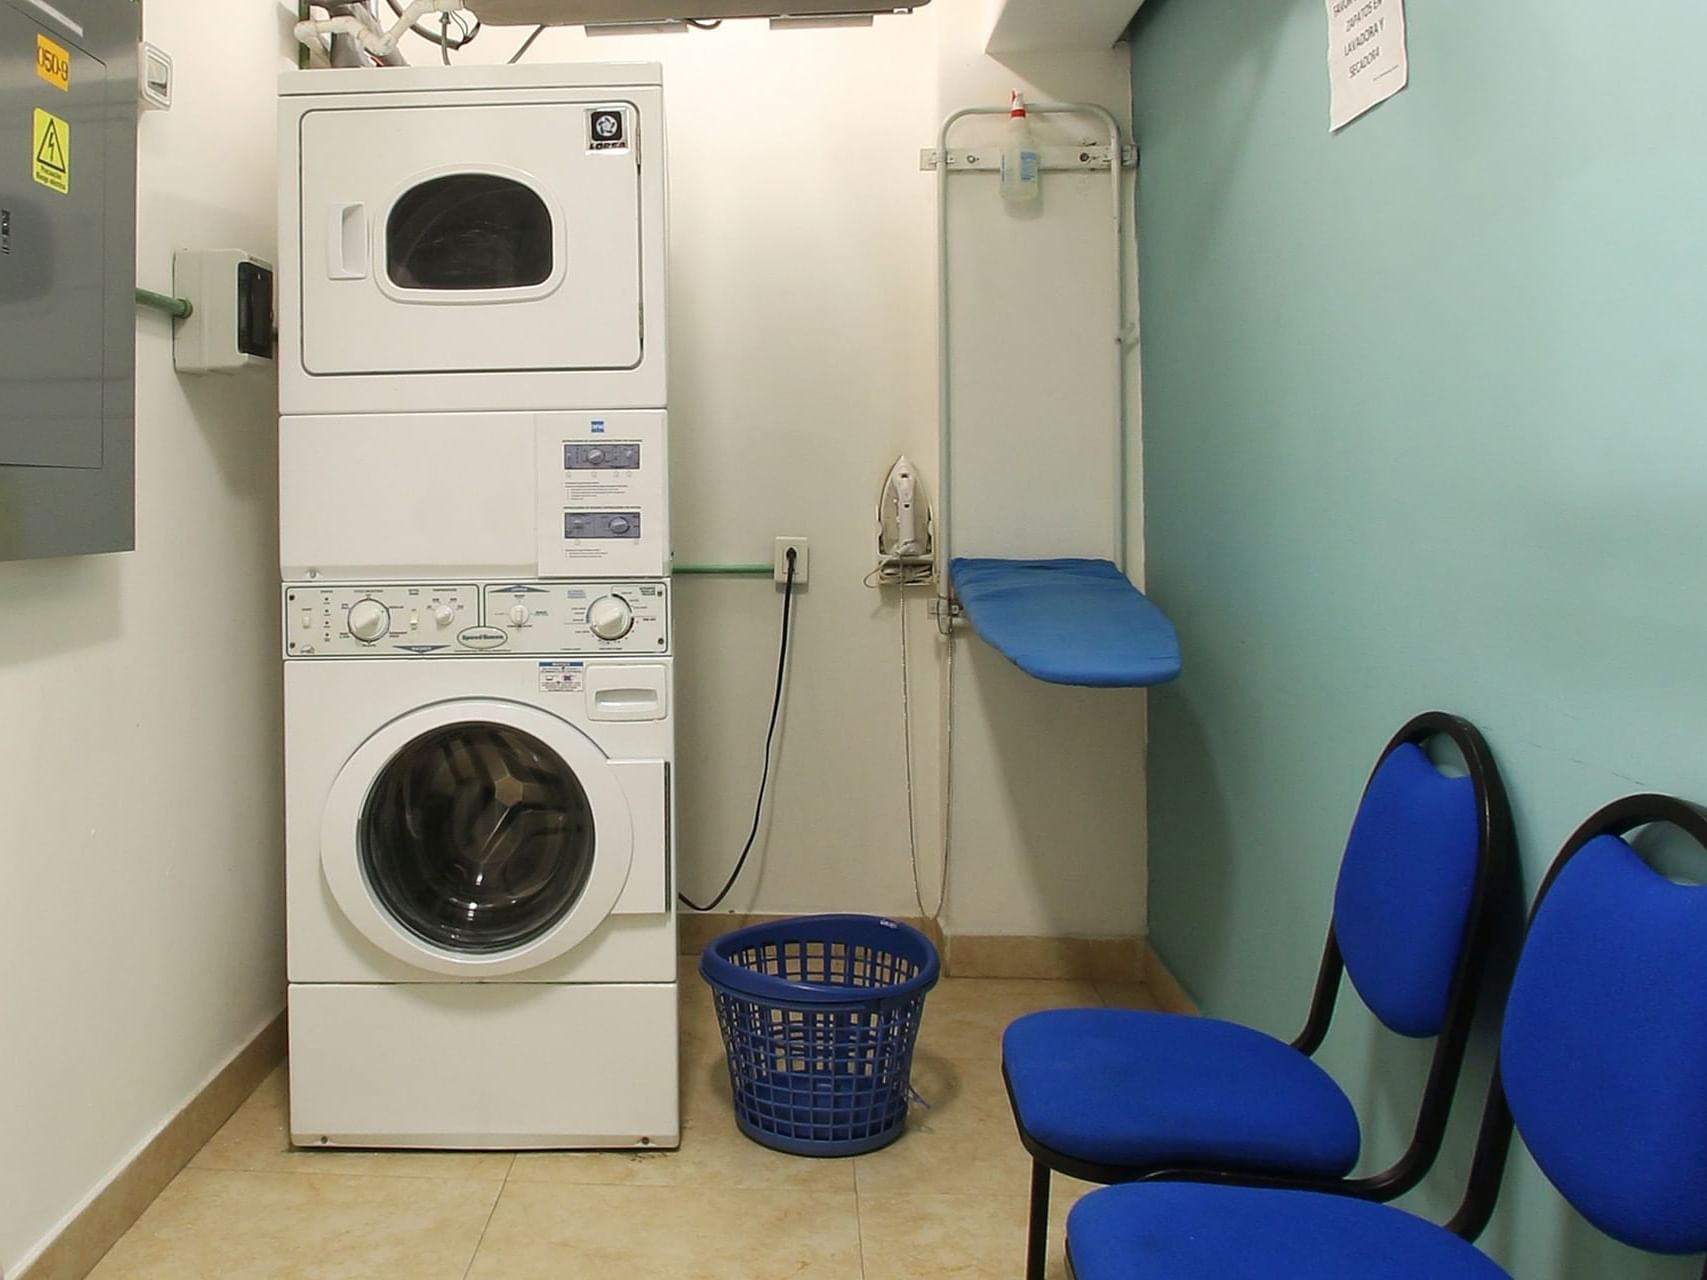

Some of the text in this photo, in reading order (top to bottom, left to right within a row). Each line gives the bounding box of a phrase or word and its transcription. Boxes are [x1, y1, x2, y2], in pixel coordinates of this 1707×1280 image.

[1346, 0, 1373, 32] ZAPATOS
[1344, 16, 1385, 56] LAVADORA Y
[1349, 46, 1380, 78] SECADORA
